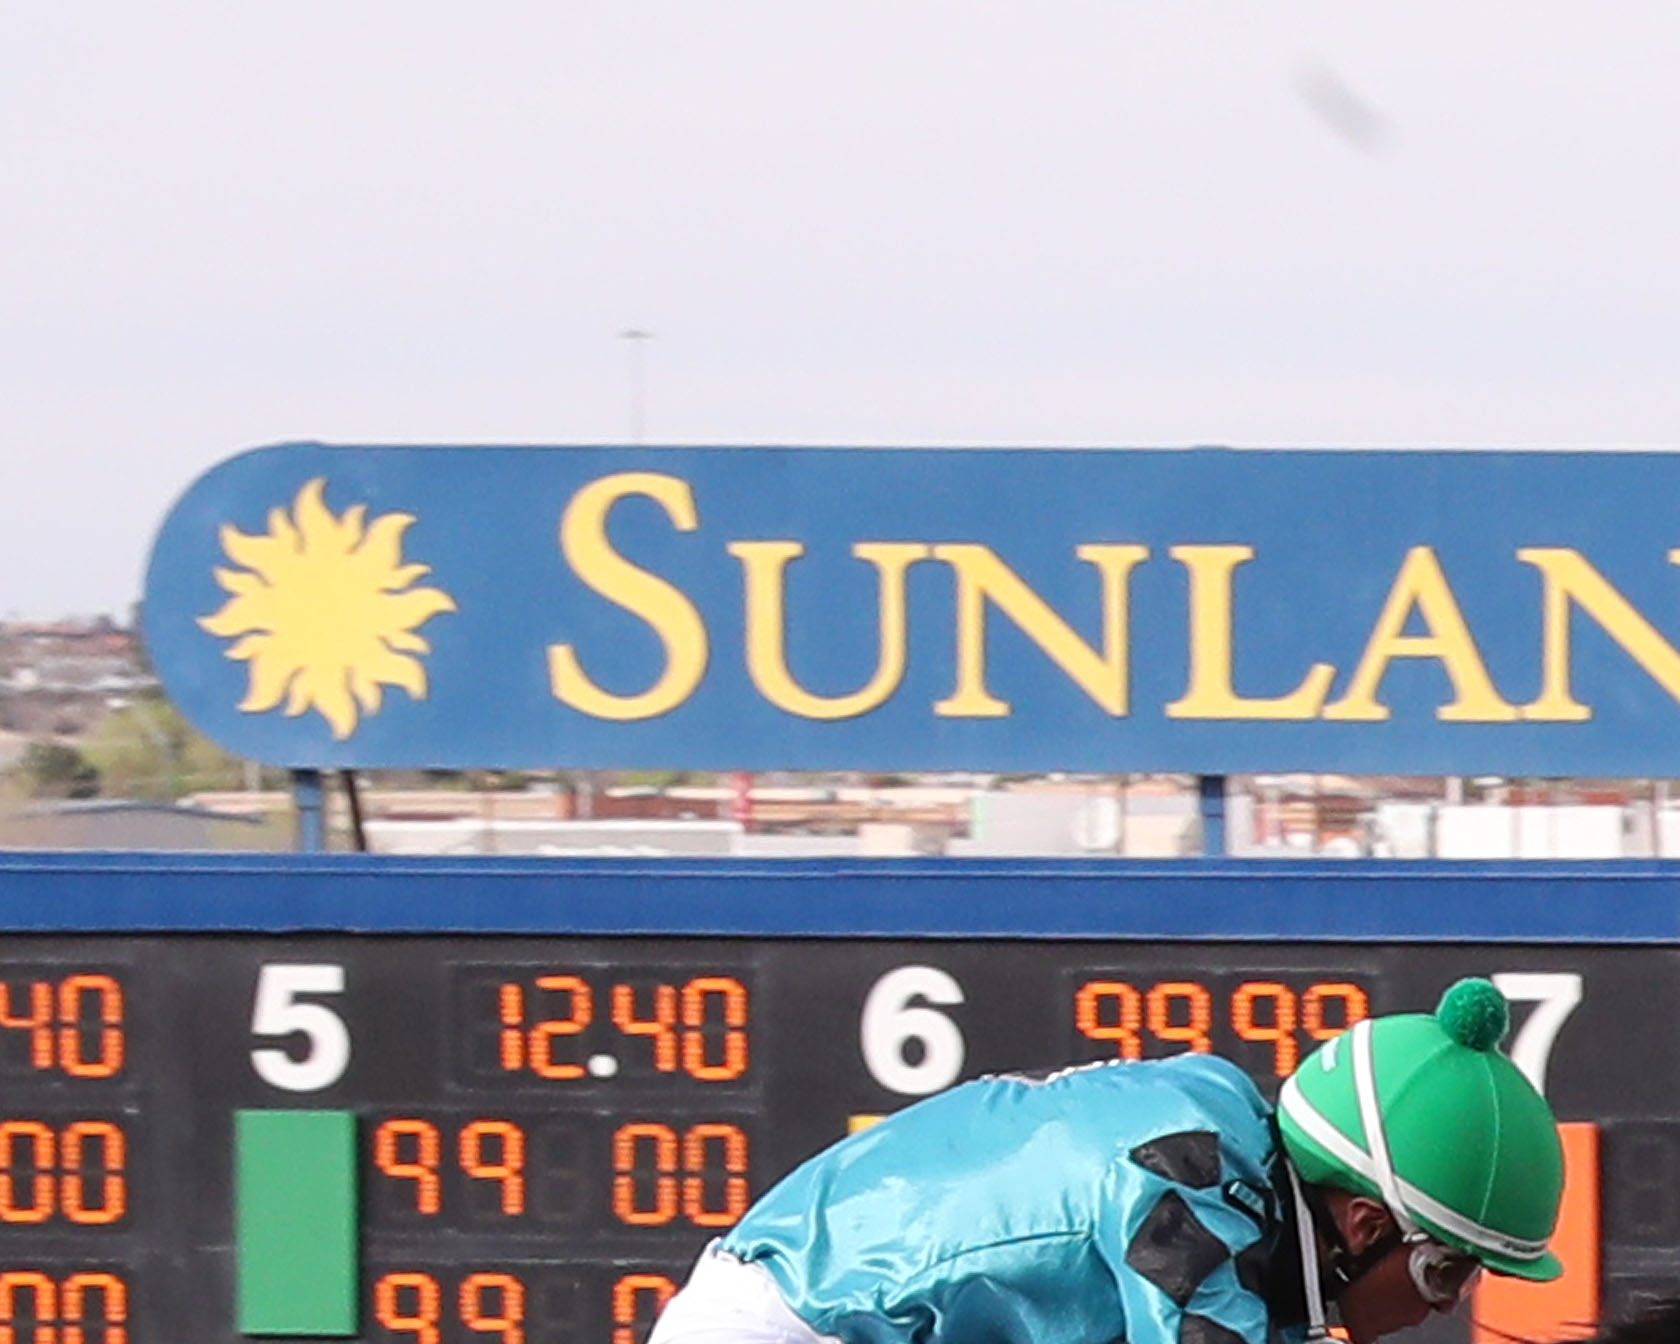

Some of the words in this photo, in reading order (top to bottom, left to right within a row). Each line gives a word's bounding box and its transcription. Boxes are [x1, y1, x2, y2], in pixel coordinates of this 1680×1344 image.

[251, 964, 350, 1091] 5
[499, 975, 748, 1081] 12.40
[861, 966, 965, 1095] 6
[1492, 972, 1583, 1094] 7
